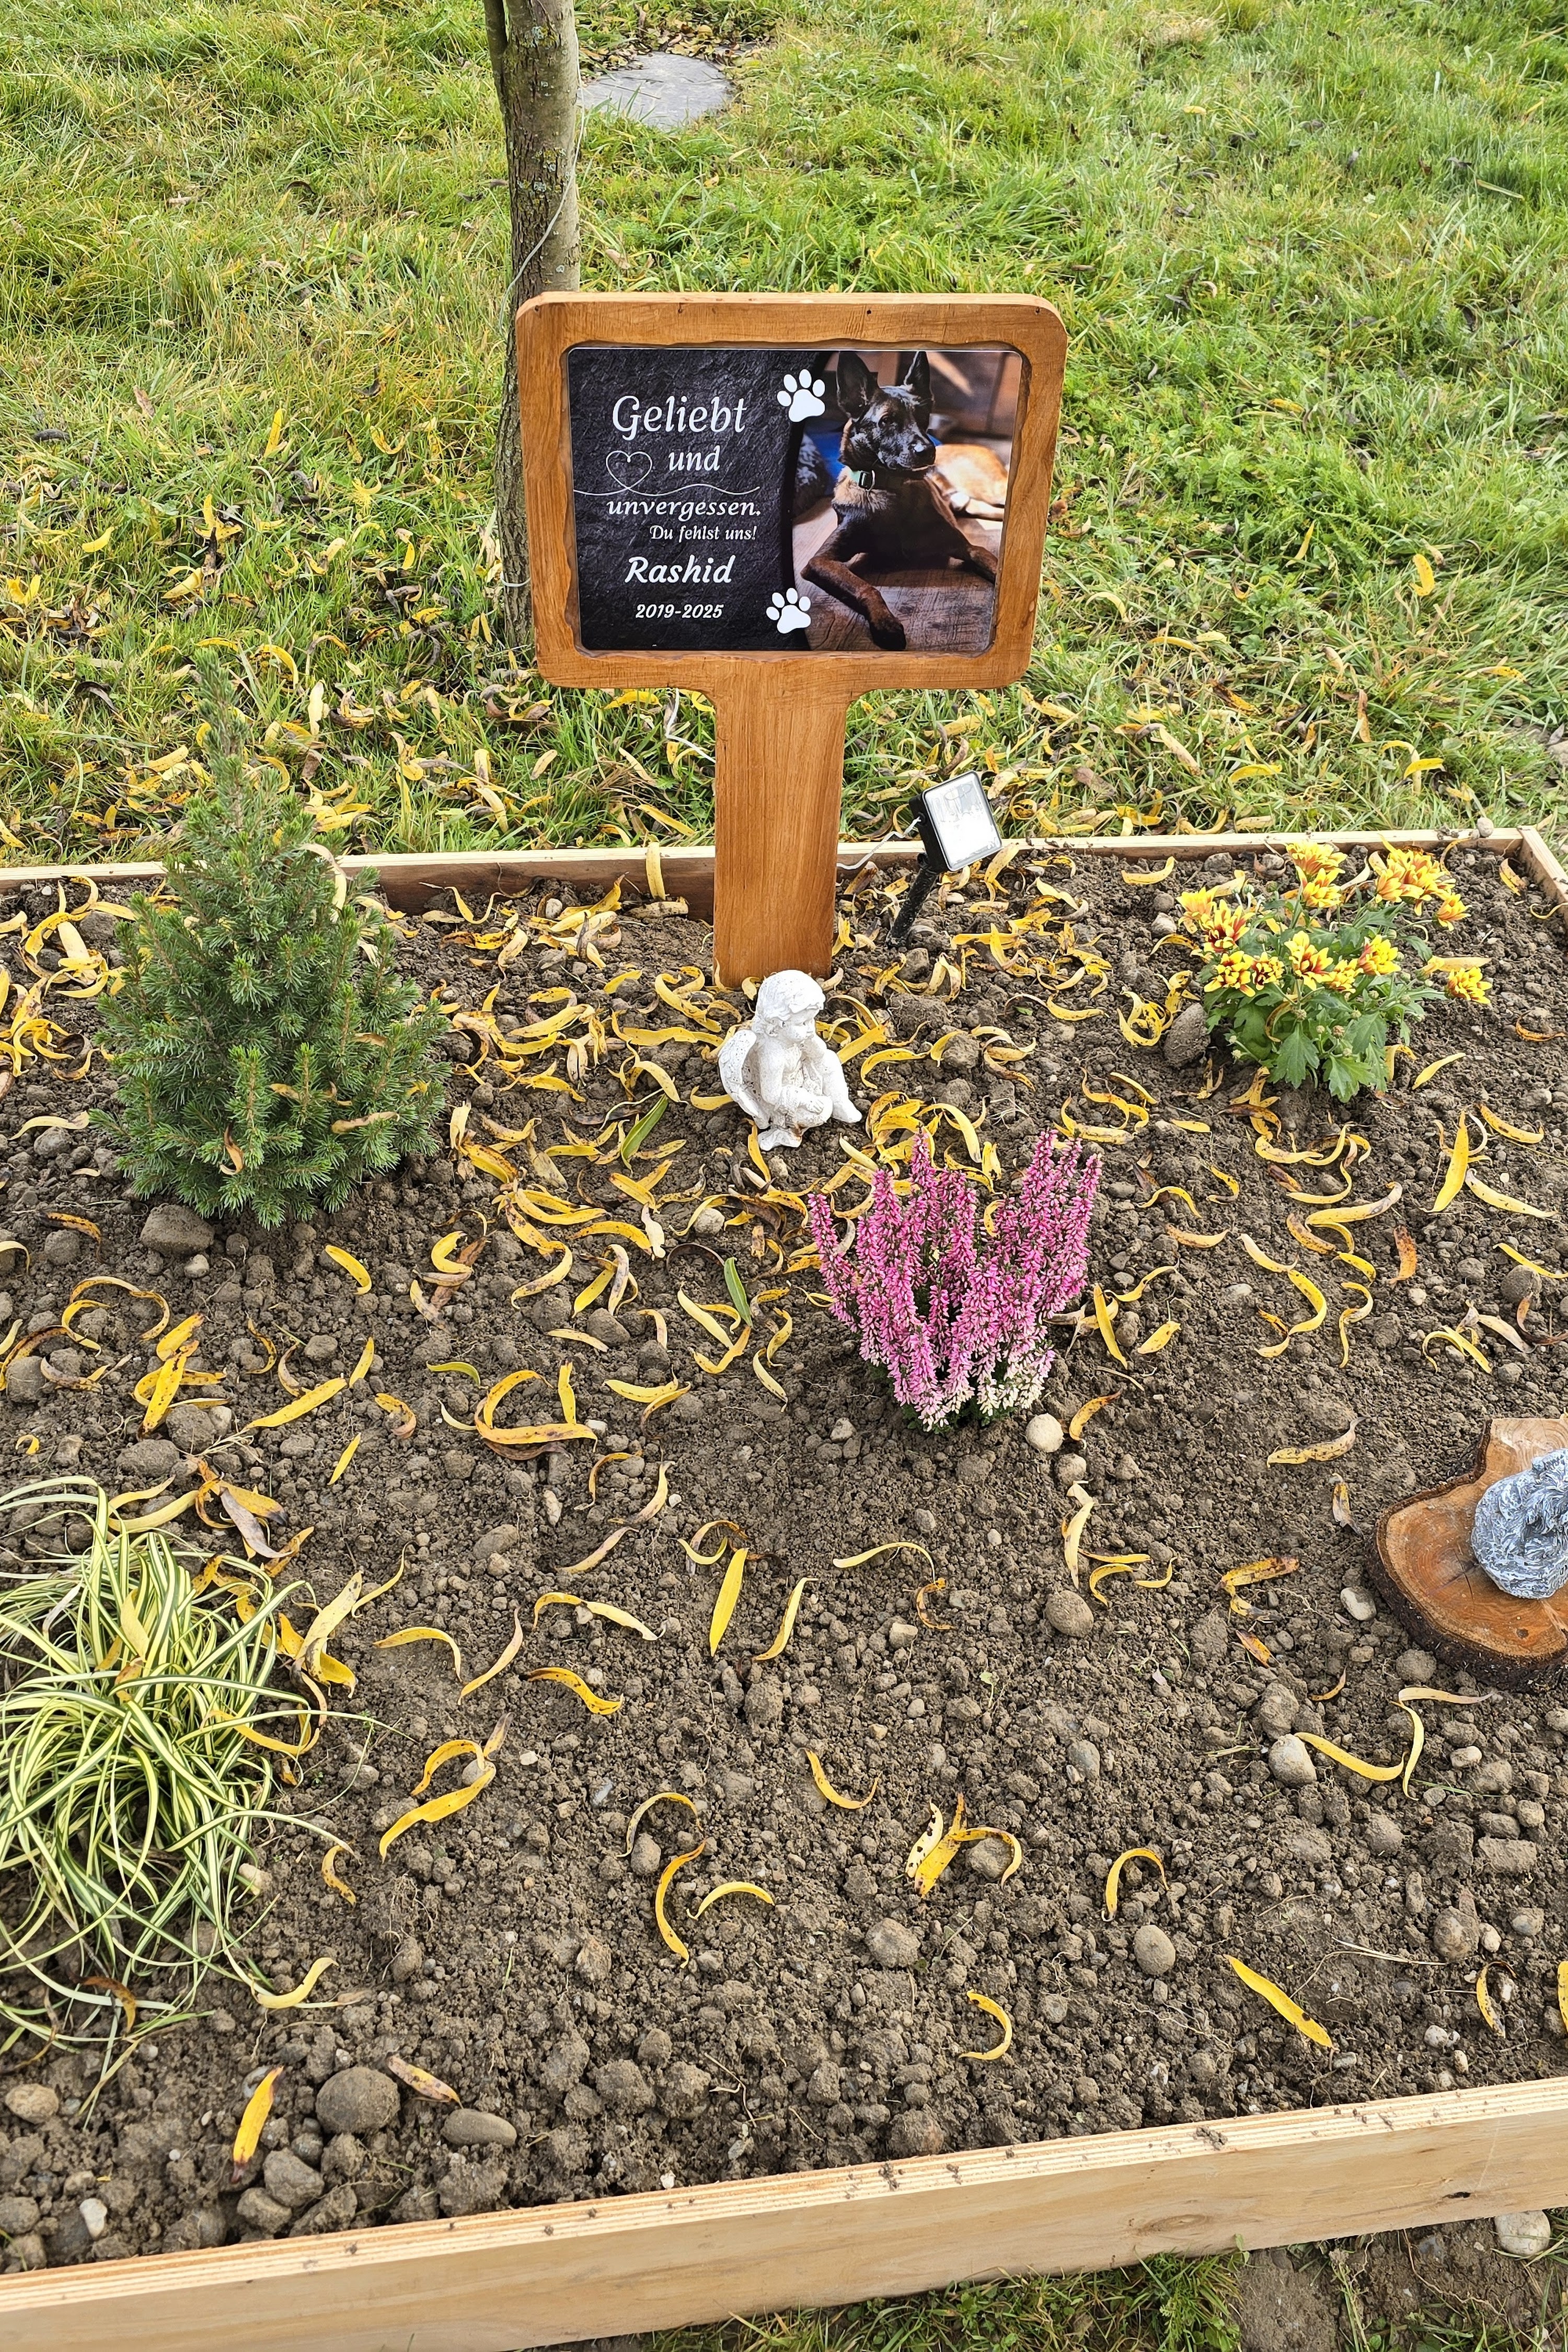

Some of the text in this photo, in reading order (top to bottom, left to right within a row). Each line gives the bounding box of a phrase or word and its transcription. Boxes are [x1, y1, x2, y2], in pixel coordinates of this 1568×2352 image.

[612, 395, 747, 441] Geliebt
[668, 445, 720, 471] und
[606, 501, 761, 522] unvergessen.
[650, 525, 757, 543] Du fehlst uns!
[625, 554, 736, 583] Rashid
[635, 604, 724, 618] 2019-2025
